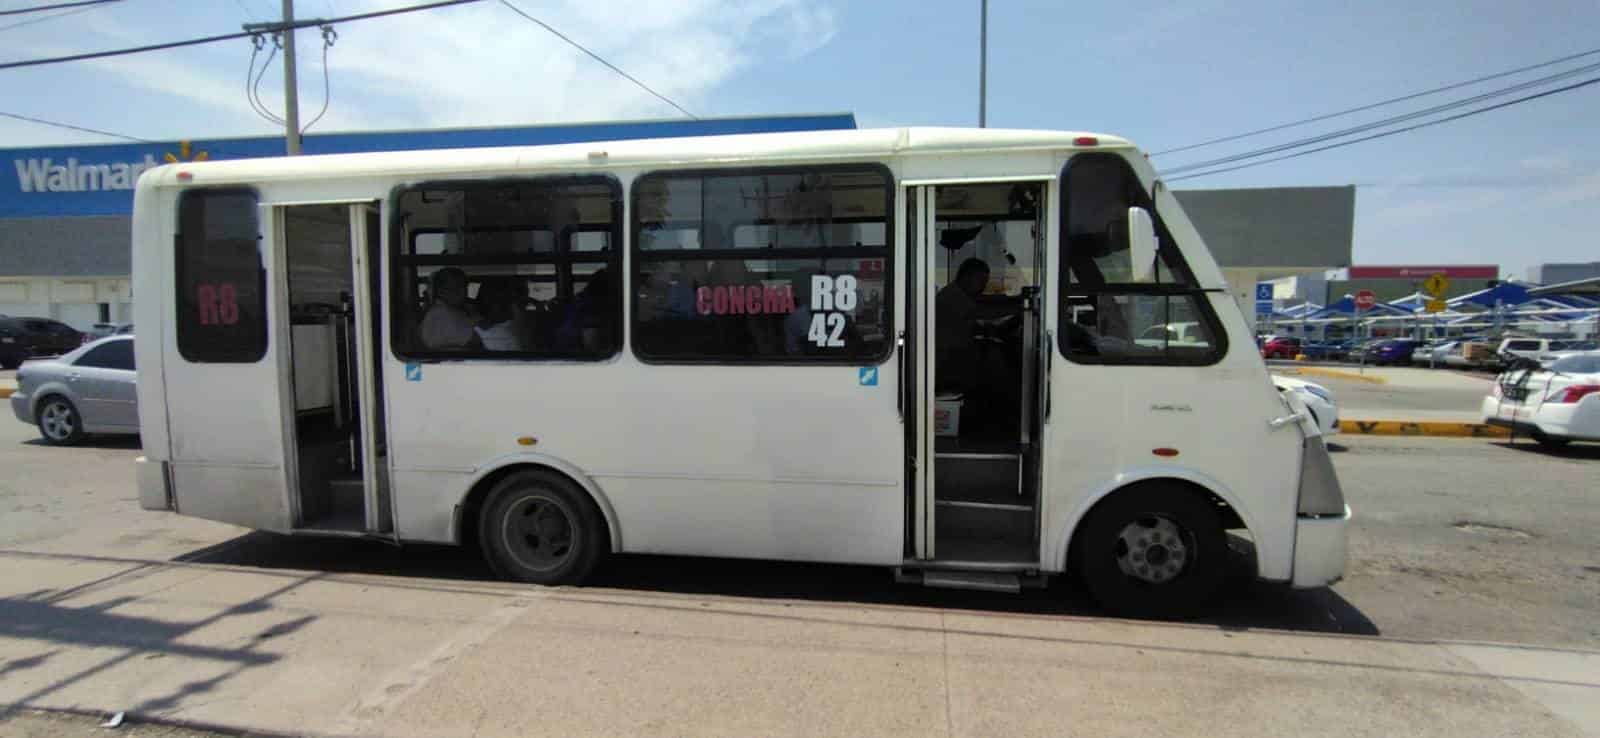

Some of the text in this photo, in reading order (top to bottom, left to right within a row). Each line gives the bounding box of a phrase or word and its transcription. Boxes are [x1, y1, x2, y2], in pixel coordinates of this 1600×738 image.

[198, 284, 239, 325] R8
[695, 284, 796, 316] CONCHA
[811, 274, 858, 312] R8
[808, 312, 846, 348] 42
